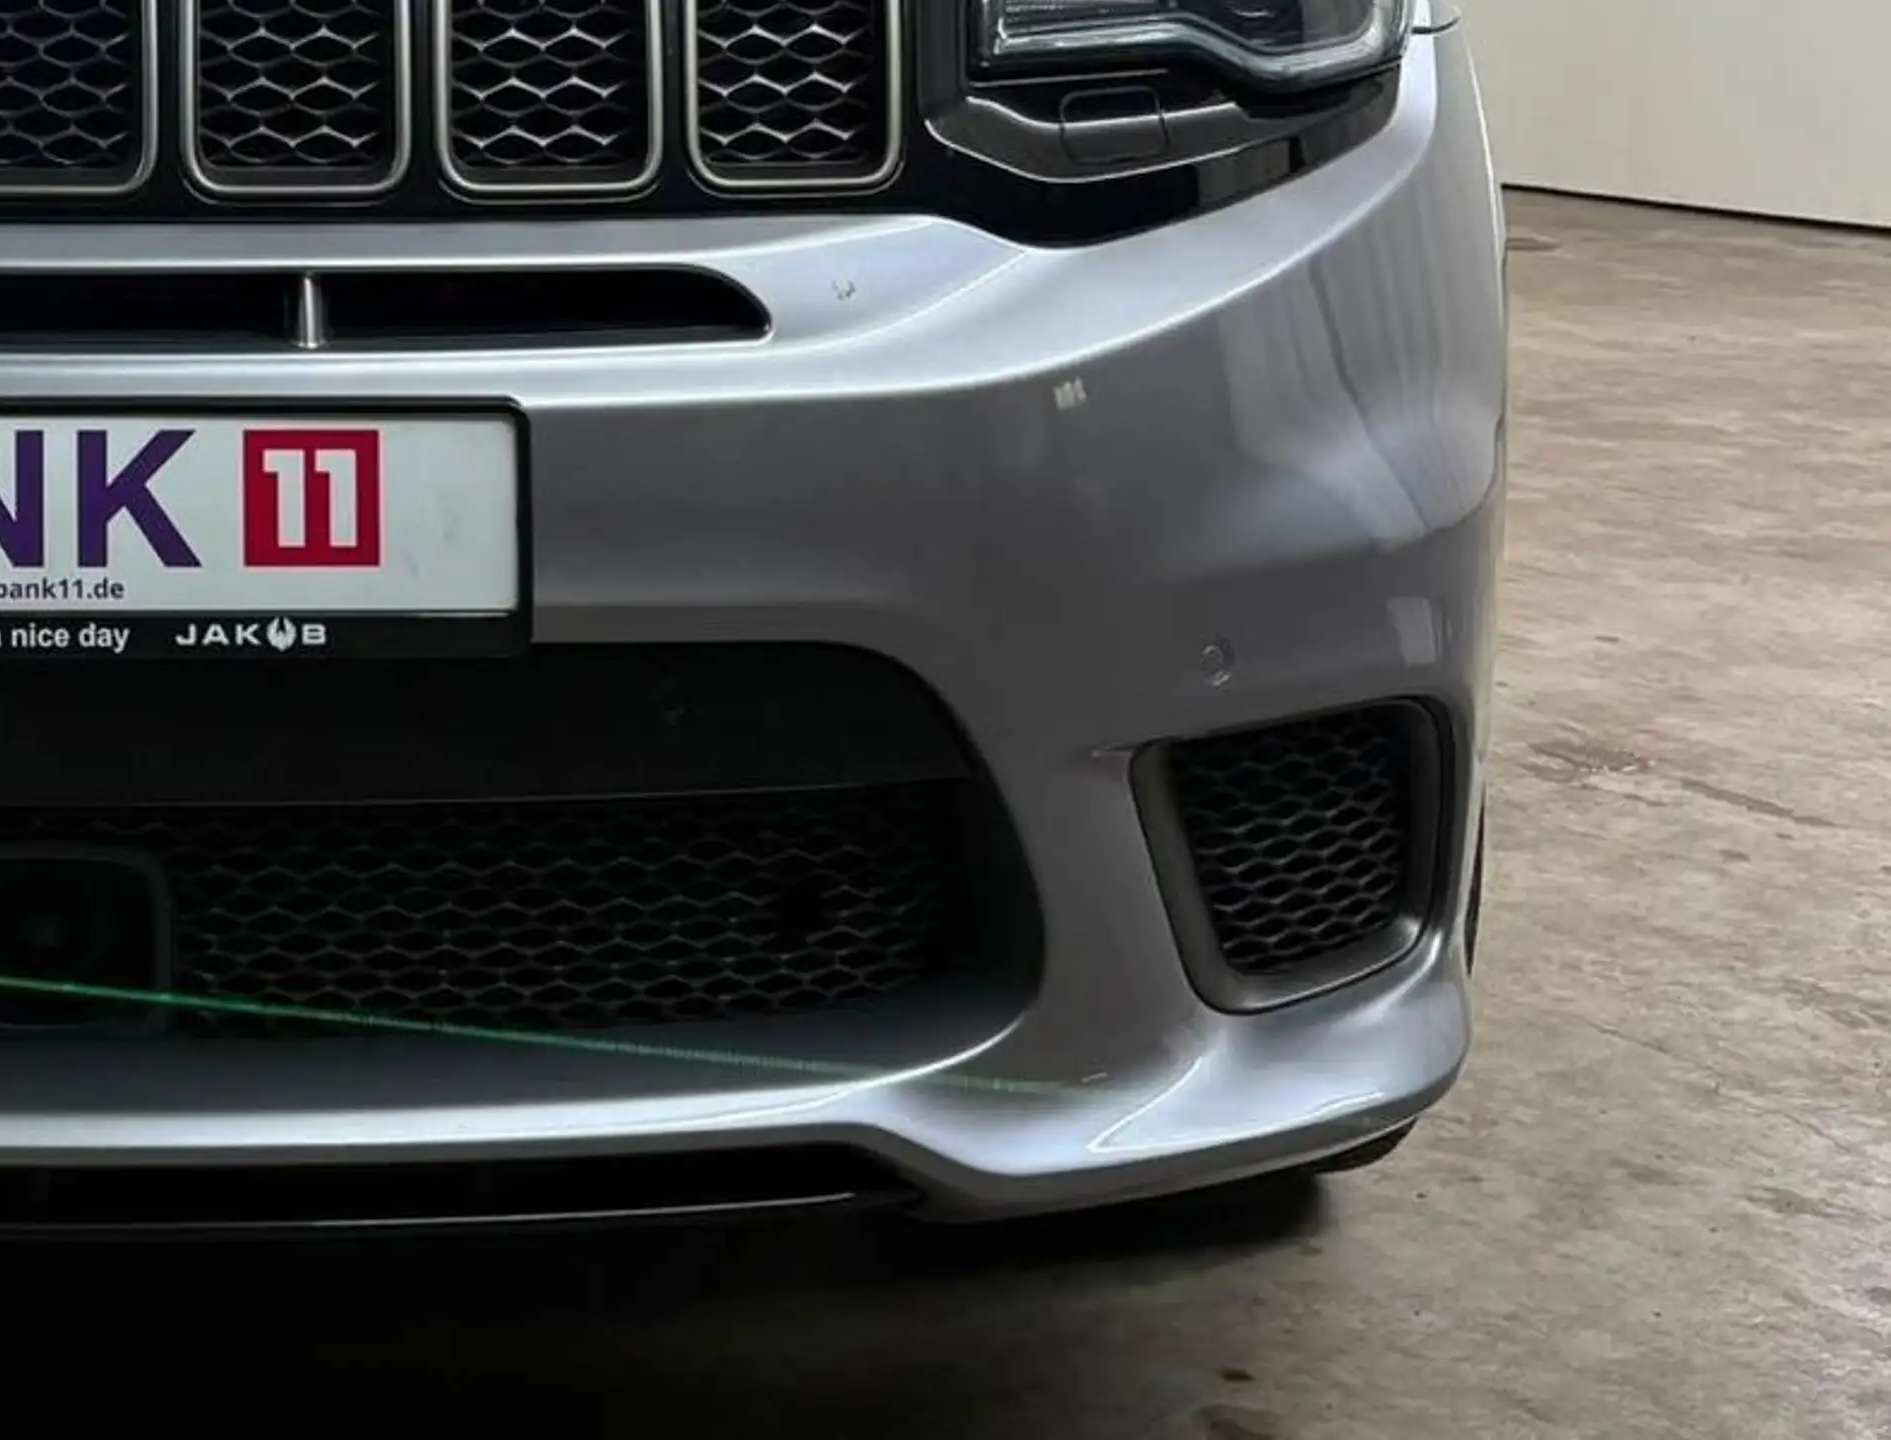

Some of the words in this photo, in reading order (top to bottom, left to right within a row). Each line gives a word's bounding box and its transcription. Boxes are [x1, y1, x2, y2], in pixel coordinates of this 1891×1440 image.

[261, 447, 358, 548] 11
[11, 622, 71, 649] nice
[78, 622, 131, 655] day
